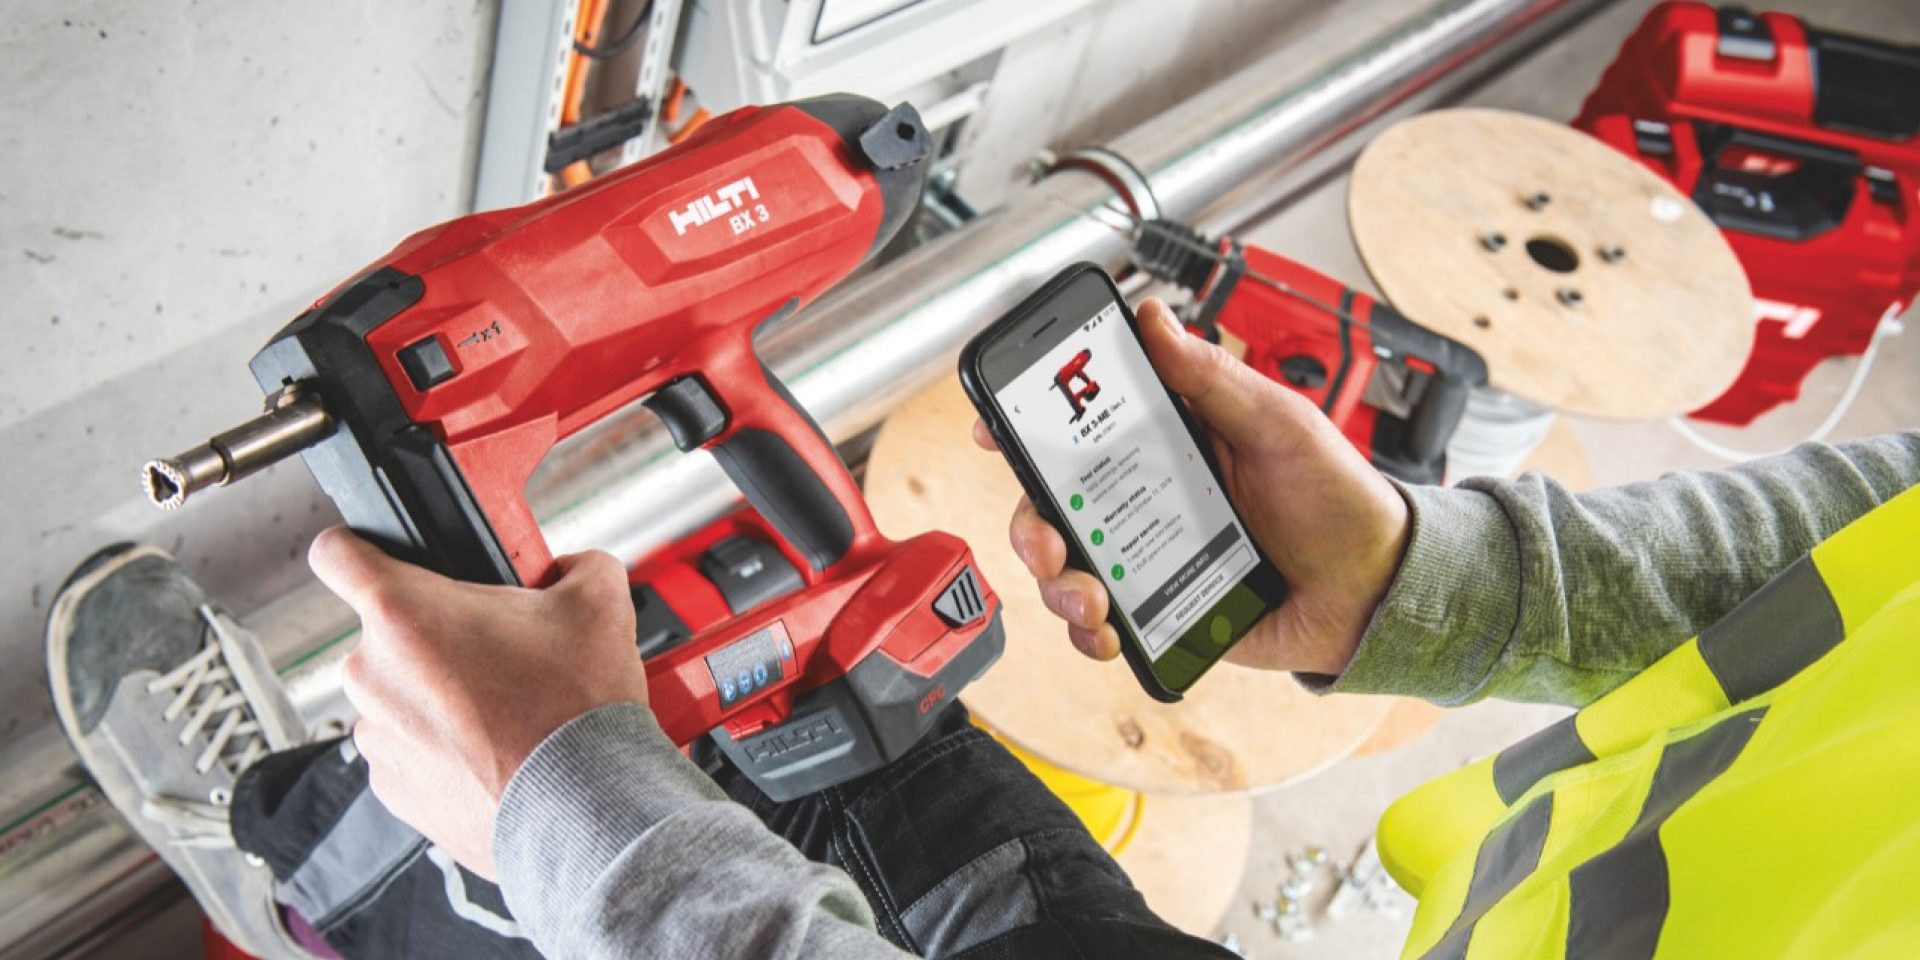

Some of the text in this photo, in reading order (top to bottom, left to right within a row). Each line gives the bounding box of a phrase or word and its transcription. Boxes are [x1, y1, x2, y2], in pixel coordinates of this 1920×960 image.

[668, 177, 760, 236] HILTI
[729, 204, 770, 236] BX 3
[1079, 424, 1091, 437] BX
[1092, 455, 1111, 473] status
[1103, 484, 1147, 525] Warranty status
[1120, 517, 1160, 554] Repair service
[1163, 553, 1209, 597] VIEW MORE INFO
[1200, 574, 1223, 597] SERVICE
[744, 714, 843, 764] HILTI
